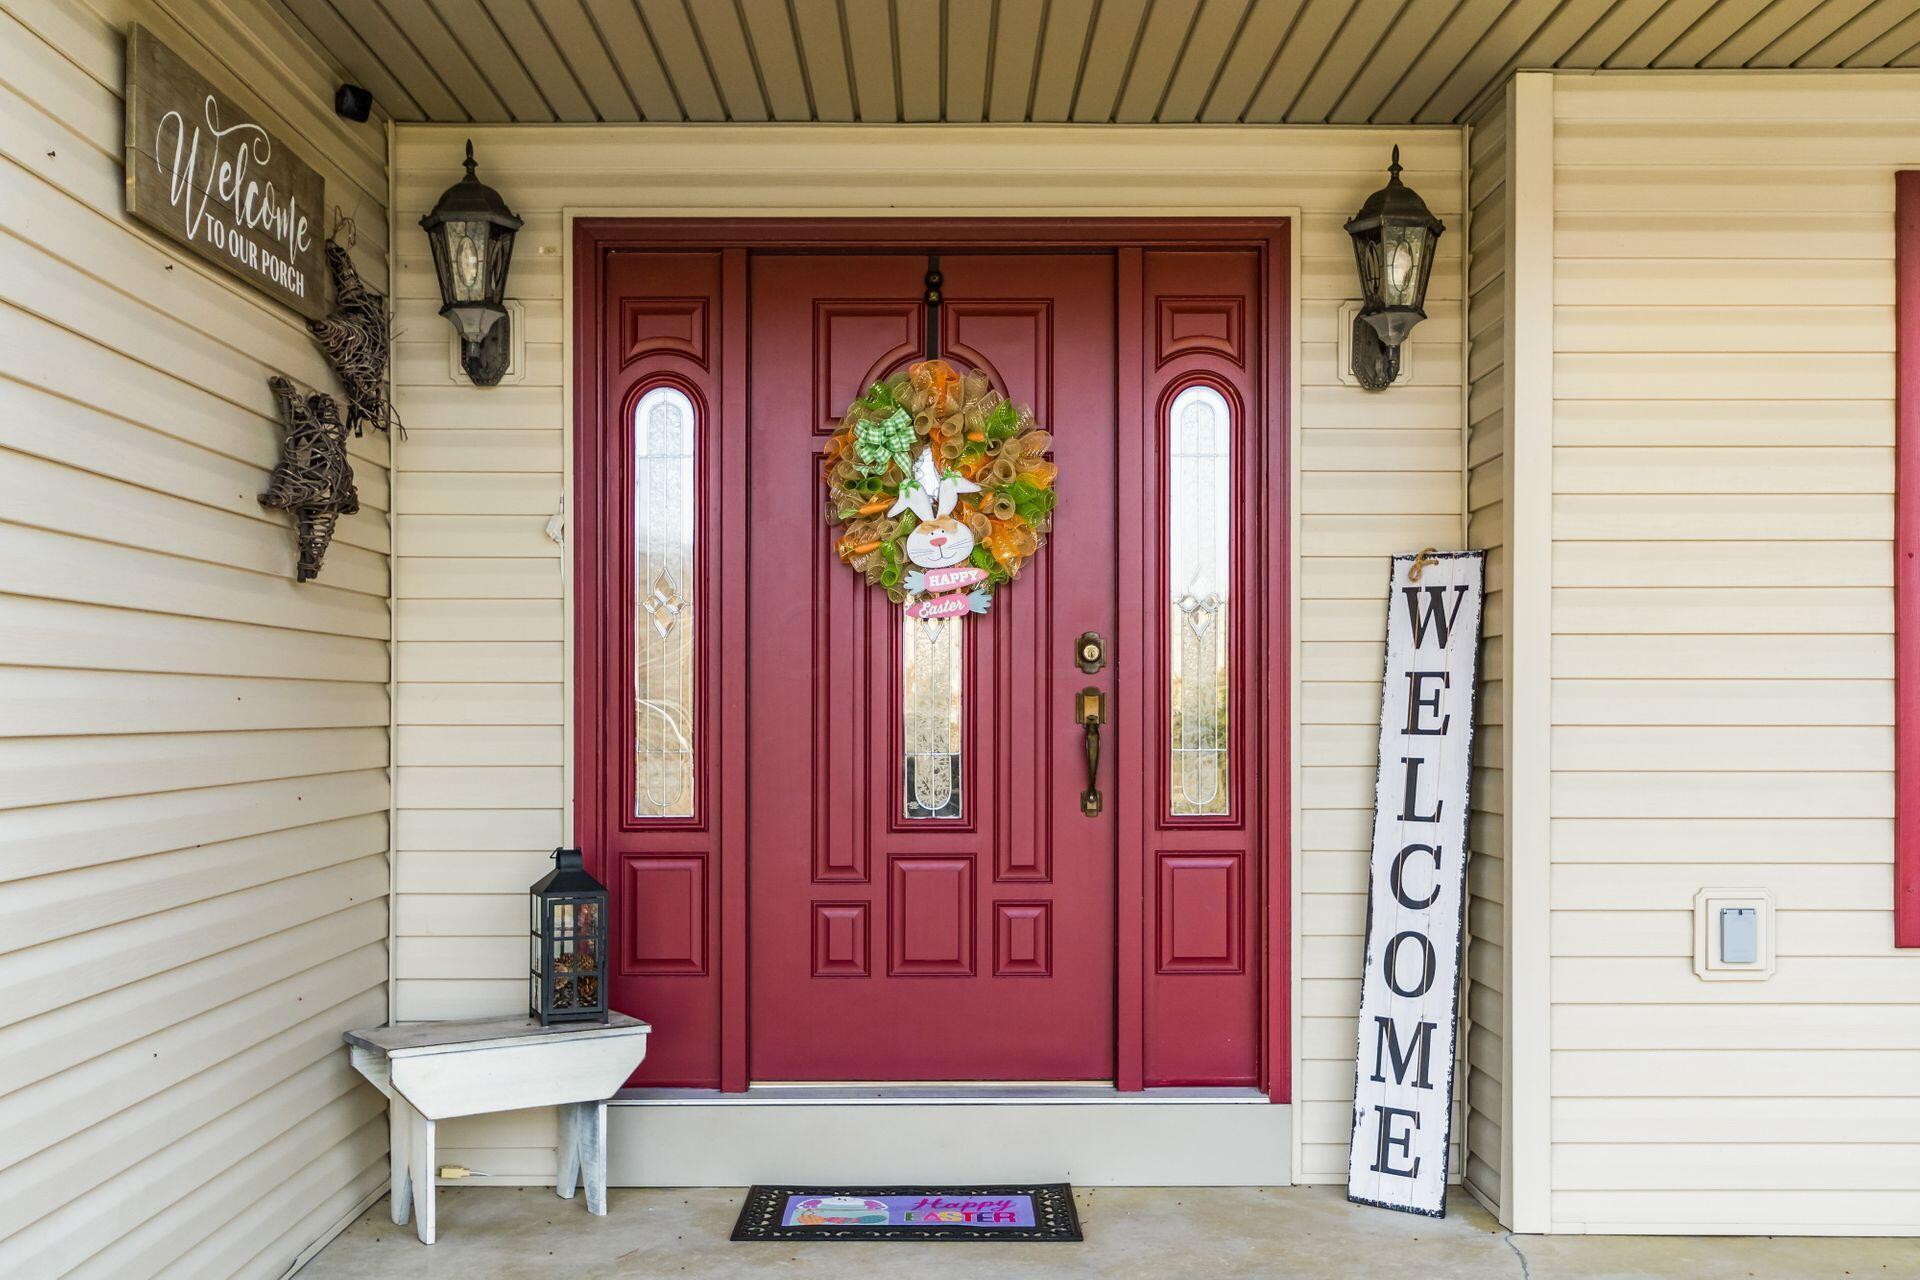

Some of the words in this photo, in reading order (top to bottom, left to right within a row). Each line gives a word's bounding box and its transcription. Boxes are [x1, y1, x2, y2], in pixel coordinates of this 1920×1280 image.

[156, 95, 311, 264] Welcome
[205, 212, 224, 249] TO
[229, 230, 258, 270] OUR
[262, 249, 304, 298] PORCH
[929, 570, 979, 586] HAPPY
[919, 600, 965, 617] Easter
[1370, 585, 1469, 1179] WELCOME
[912, 1198, 1016, 1212] Happy
[904, 1211, 1016, 1223] EASTER
